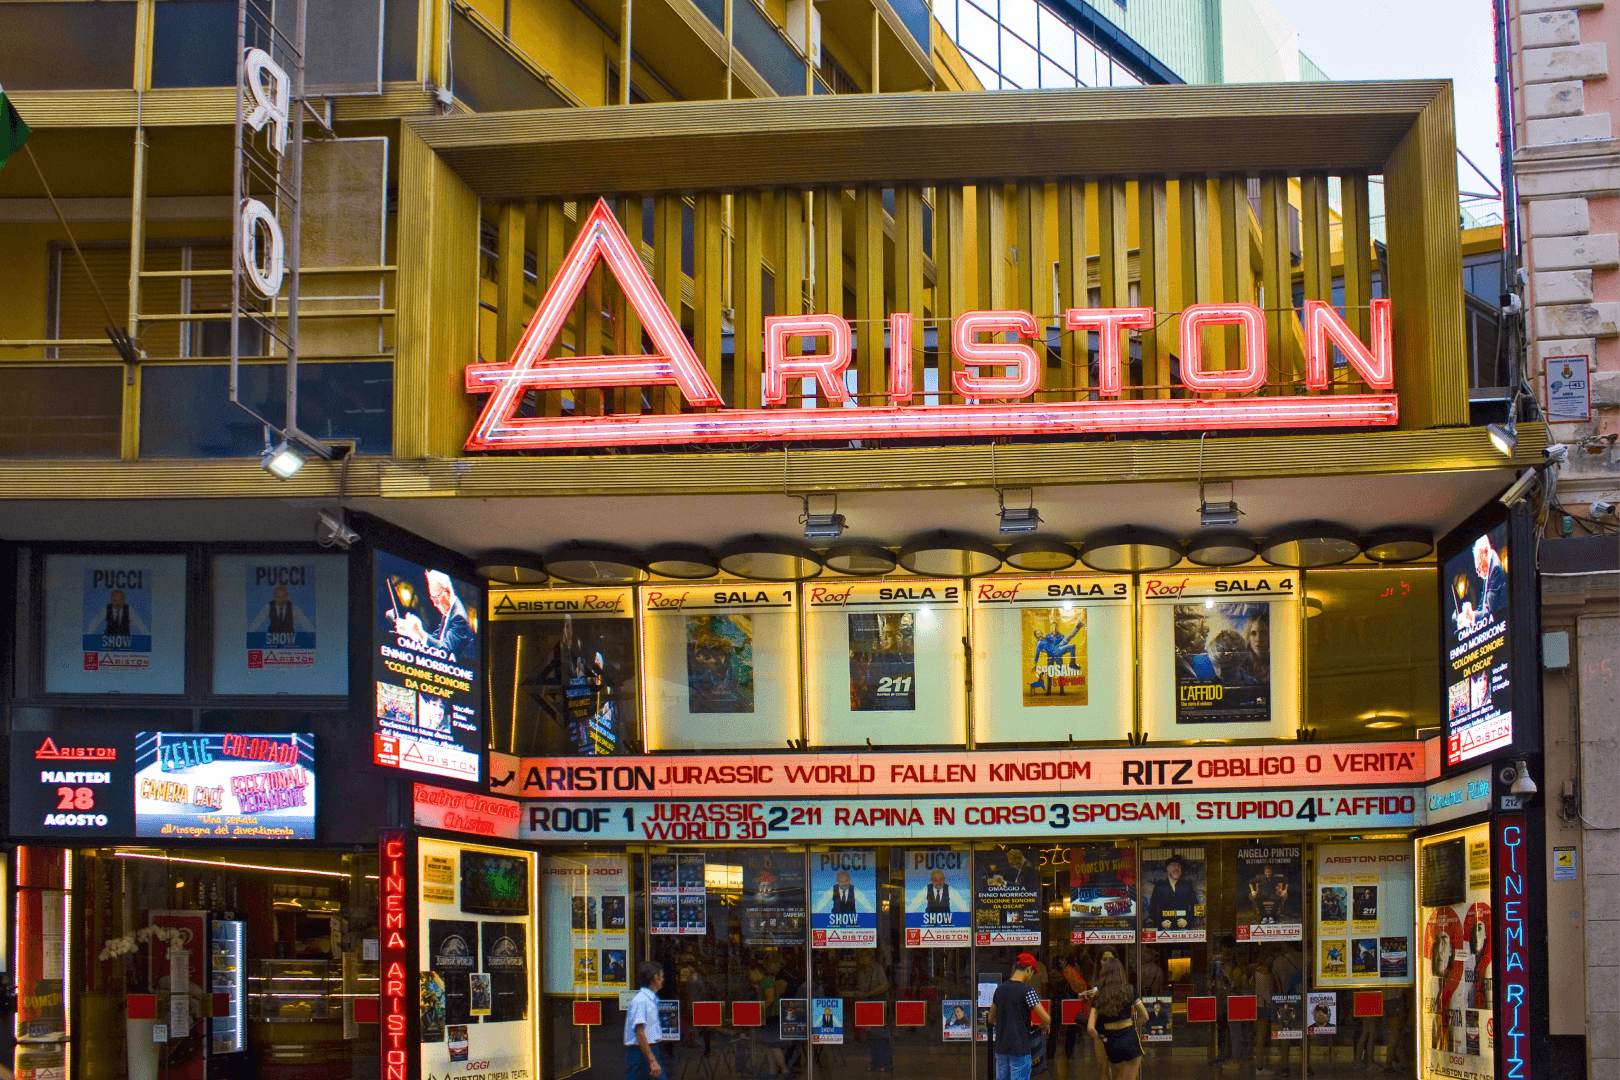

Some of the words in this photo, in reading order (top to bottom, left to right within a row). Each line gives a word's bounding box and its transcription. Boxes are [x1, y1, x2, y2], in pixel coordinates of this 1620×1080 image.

[464, 196, 1397, 452] ARISTON
[93, 569, 142, 589] PUCCI
[256, 566, 305, 586] PUCCI
[811, 587, 854, 606] Roof
[879, 588, 937, 600] SALA
[945, 586, 958, 599] 2
[978, 583, 1022, 603] Roof
[1047, 584, 1104, 597] SALA
[1113, 583, 1127, 595] 3
[1145, 578, 1189, 599] Roof
[1214, 580, 1270, 593] SALA
[1279, 579, 1293, 591] 4
[494, 595, 579, 615] ARISTON
[583, 593, 624, 612] Roof
[647, 591, 689, 612] Roof
[714, 591, 769, 604] SALA
[782, 590, 792, 602] 1
[1458, 617, 1488, 641] OMAGGIO
[1489, 613, 1494, 624] A
[102, 635, 132, 648] SHOW
[266, 632, 296, 645] SHOW
[1450, 642, 1468, 660] ENNIO
[1468, 620, 1507, 650] MORRICONE
[1480, 635, 1505, 656] SONORE
[396, 637, 447, 659] OMAGGIO
[448, 653, 456, 662] A
[380, 645, 414, 662] ENNIO
[415, 655, 474, 680] MORRICONE
[1463, 666, 1471, 678] DA
[404, 679, 419, 690] DA
[434, 674, 470, 692] SONORE
[877, 676, 912, 692] 211
[1180, 685, 1223, 701] L'AFFIDO
[34, 736, 116, 760] ARISTON
[1462, 724, 1510, 753] ARISTON
[160, 738, 213, 772] ZELIG
[222, 733, 300, 767] COLORADO
[402, 743, 477, 774] ARISTON
[523, 766, 655, 791] ARISTON
[658, 765, 774, 785] JURASSIC
[784, 764, 875, 784] WORLD
[891, 763, 976, 783] FALLEN
[989, 761, 1091, 783] KINGDOM
[1122, 759, 1193, 786] RITZ
[1197, 755, 1295, 778] OBBLIGO
[1305, 754, 1322, 773] O
[1332, 751, 1416, 773] VERITA'
[140, 778, 188, 804] CAMERA
[230, 768, 309, 796] ECCEZIONALE
[57, 786, 94, 810] 28
[238, 787, 308, 815] VERAMENTE
[463, 793, 521, 818] Cinema
[1505, 798, 1519, 807] 212
[43, 813, 108, 827] AGOSTO
[225, 815, 258, 825] serata
[529, 806, 610, 832] ROOF
[623, 806, 634, 832] 1
[646, 803, 764, 822] JURASSIC
[768, 806, 790, 831] 2
[791, 806, 823, 827] 211
[834, 806, 923, 827] RAPINA
[933, 805, 956, 826] IN
[964, 804, 1046, 826] CORSO
[1049, 803, 1071, 829] 3
[1072, 801, 1187, 825] SPOSAMI,
[1196, 799, 1294, 820] STUPIDO
[1296, 798, 1318, 822] 4
[1317, 795, 1416, 816] L'AFFIDO
[160, 824, 210, 836] all'insegna
[214, 824, 229, 835] del
[233, 825, 294, 836] divertimento
[641, 820, 730, 840] WORLD
[737, 819, 768, 840] 3D
[820, 853, 867, 871] PUCCI
[914, 852, 961, 870] PUCCI
[1238, 848, 1269, 858] ANGELO
[1271, 848, 1300, 857] PINTUS
[386, 840, 405, 948] CINEMA
[1503, 826, 1524, 972] CINEMA
[829, 913, 859, 925] SHOW
[923, 912, 953, 924] SHOW
[828, 930, 875, 942] ARISTON
[921, 929, 969, 942] ARISTON
[992, 933, 1038, 942] ARISTON
[1086, 931, 1134, 941] ARISTON
[1157, 931, 1204, 939] ARISTON
[1251, 925, 1300, 936] ARISTON
[23, 993, 61, 1007] COMED
[816, 999, 839, 1008] PUCCI
[386, 962, 405, 1080] ARISTON
[1506, 984, 1526, 1079] RITZ
[466, 1061, 490, 1071] OGGI
[1435, 1062, 1463, 1078] ARISTON
[1463, 1070, 1478, 1080] RITZ
[1449, 1056, 1465, 1066] OGGI
[488, 1072, 509, 1080] CINEMA
